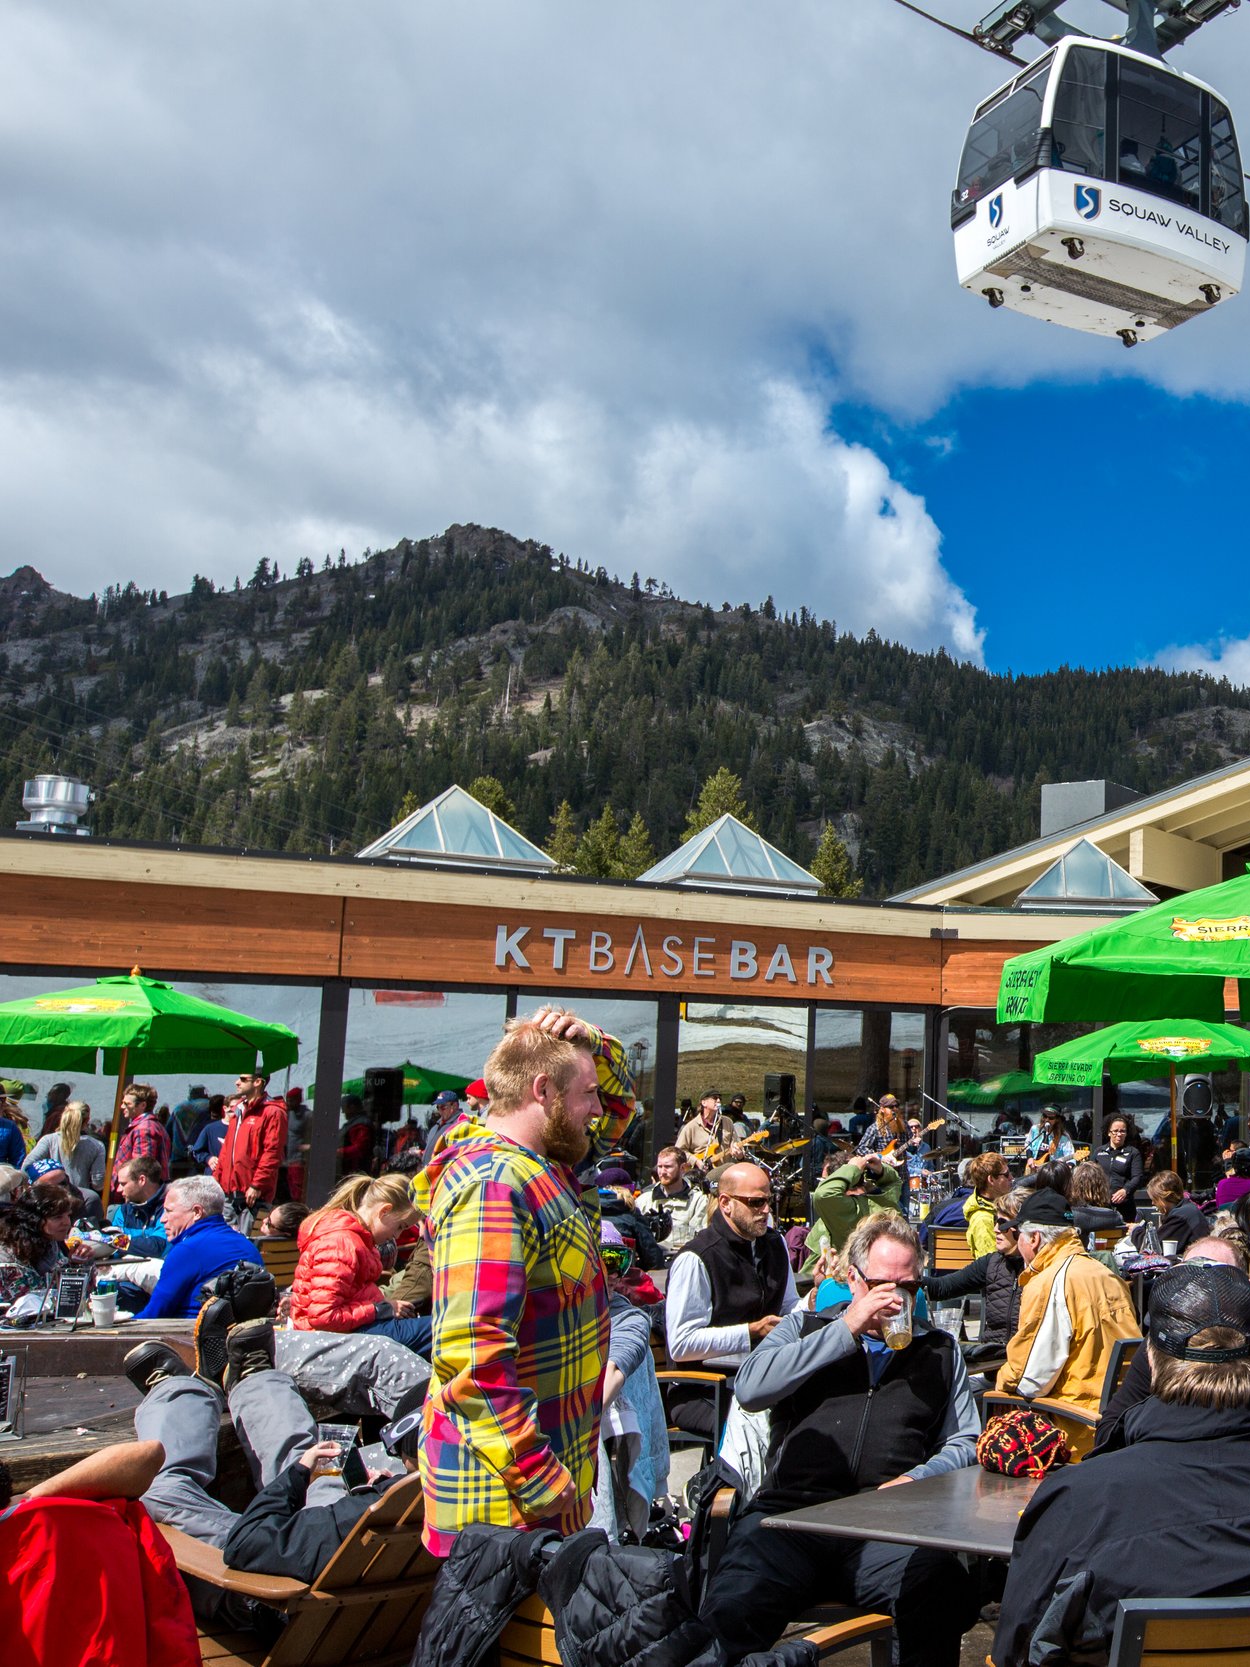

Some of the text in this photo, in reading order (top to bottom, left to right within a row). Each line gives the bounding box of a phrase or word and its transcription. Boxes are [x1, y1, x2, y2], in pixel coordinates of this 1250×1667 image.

[1109, 199, 1230, 254] SQUAW VALLEY
[374, 1077, 386, 1086] UP
[1049, 1073, 1075, 1082] BREWING
